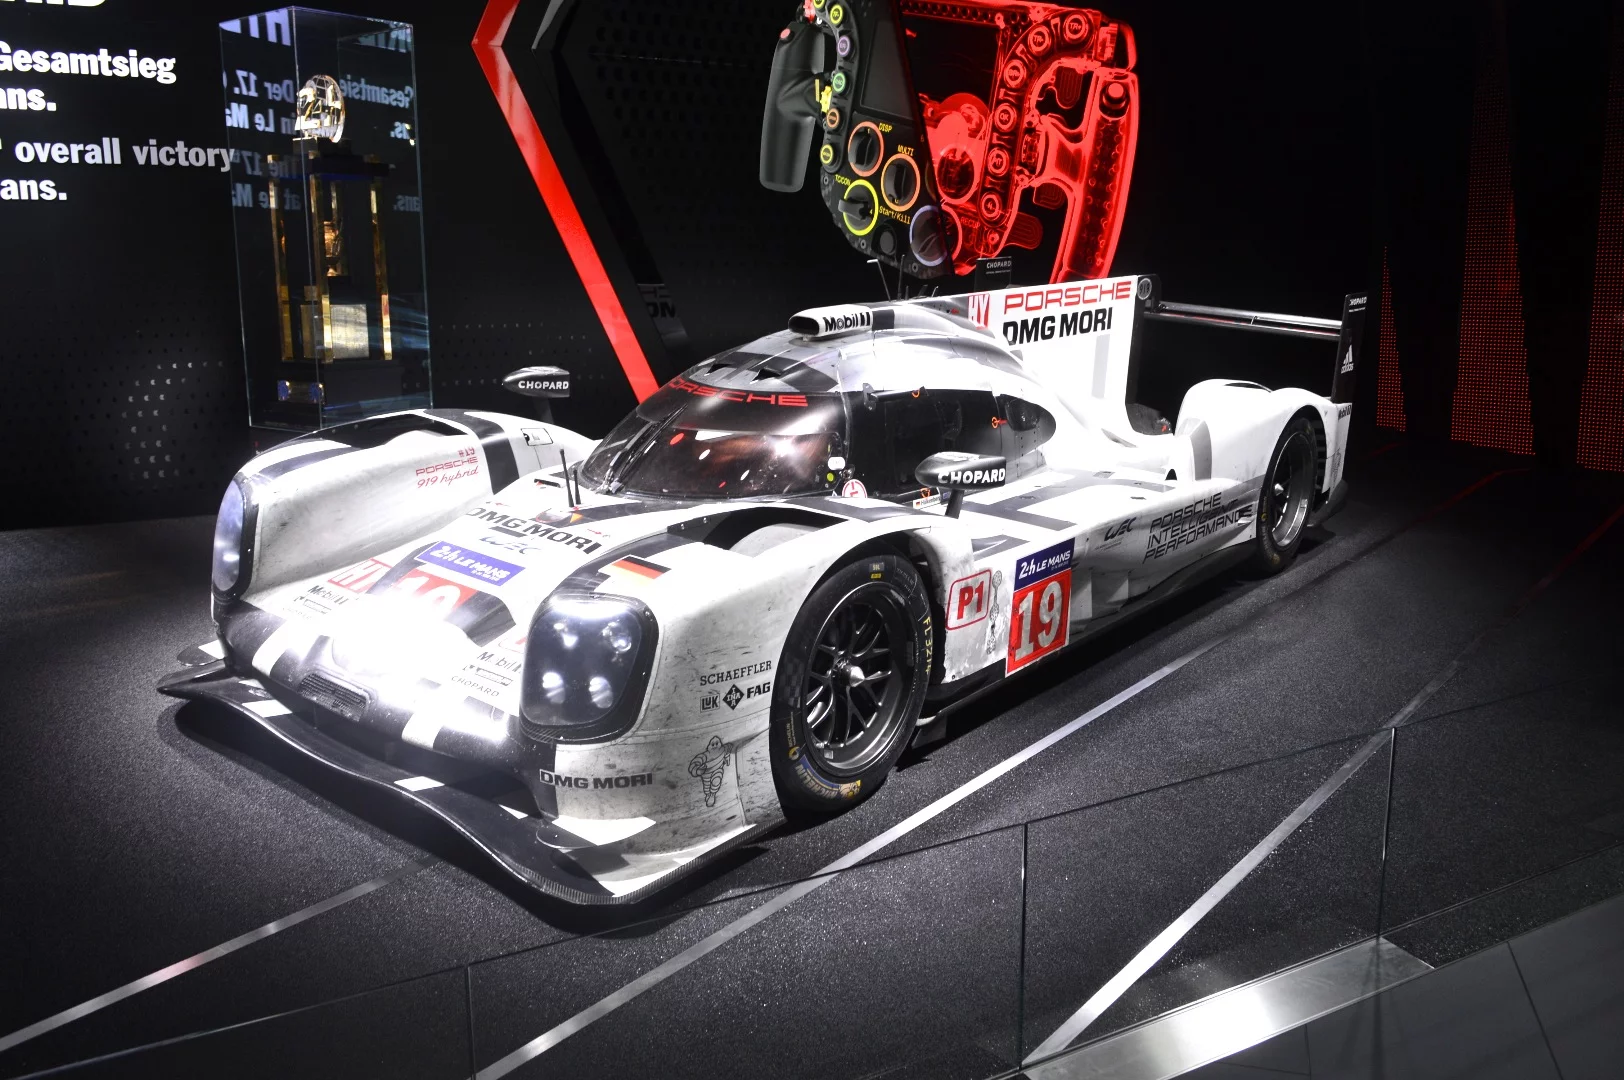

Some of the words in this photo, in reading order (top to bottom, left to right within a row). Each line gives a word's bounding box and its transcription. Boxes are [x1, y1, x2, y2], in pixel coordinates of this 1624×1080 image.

[0, 41, 177, 84] Gesamtsieg
[15, 137, 122, 164] overall
[132, 139, 235, 172] victory
[0, 179, 68, 200] ans.
[1004, 281, 1131, 314] PORSCHE
[823, 313, 858, 332] Mobil
[1003, 316, 1055, 345] DMG
[1059, 307, 1113, 337] MORI
[518, 381, 569, 390] CHOPARD
[415, 457, 478, 476] PORSCHE
[417, 476, 439, 488] 919
[440, 466, 478, 486] hybrid
[938, 468, 1006, 484] CHOPARD
[1146, 499, 1239, 549] INTELLIGENT
[1150, 492, 1222, 533] PORSCHE
[466, 508, 522, 529] DMG
[523, 522, 603, 555] MORI
[1104, 516, 1137, 541] WEC
[1142, 504, 1254, 564] PERFORMANCE
[1018, 558, 1036, 580] 24h
[1036, 559, 1048, 573] LE
[1047, 550, 1071, 567] MANS
[956, 580, 984, 620] P1
[1014, 580, 1063, 662] 19
[451, 675, 500, 697] CHOPARD
[700, 660, 772, 686] SCHAEFFLER
[746, 681, 771, 699] FAG
[541, 770, 589, 789] DMG
[593, 773, 653, 790] MORI
